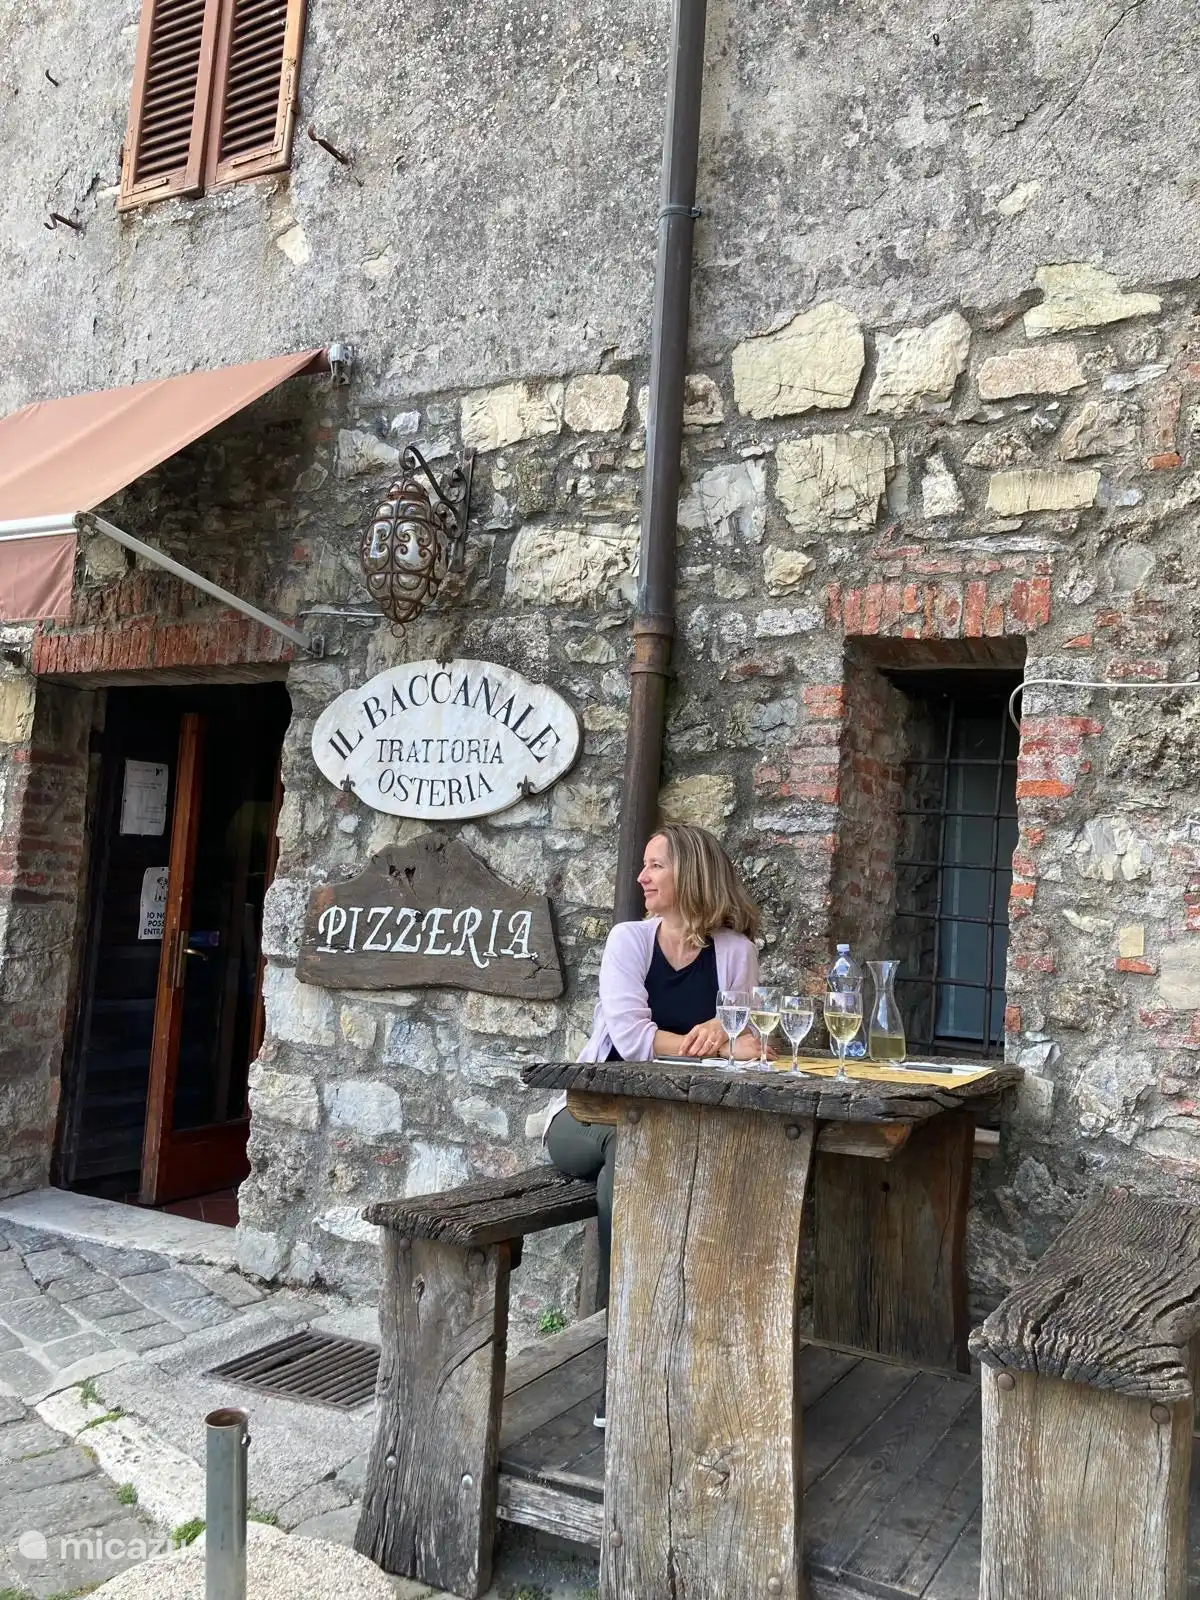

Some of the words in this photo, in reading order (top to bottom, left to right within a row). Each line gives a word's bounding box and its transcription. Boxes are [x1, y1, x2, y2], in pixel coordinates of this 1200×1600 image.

[328, 728, 364, 761] IL
[362, 671, 561, 764] BACCANALE
[376, 738, 504, 765] TRATTORIA
[378, 768, 493, 807] OSTERIA
[316, 905, 537, 969] PIZZERIA
